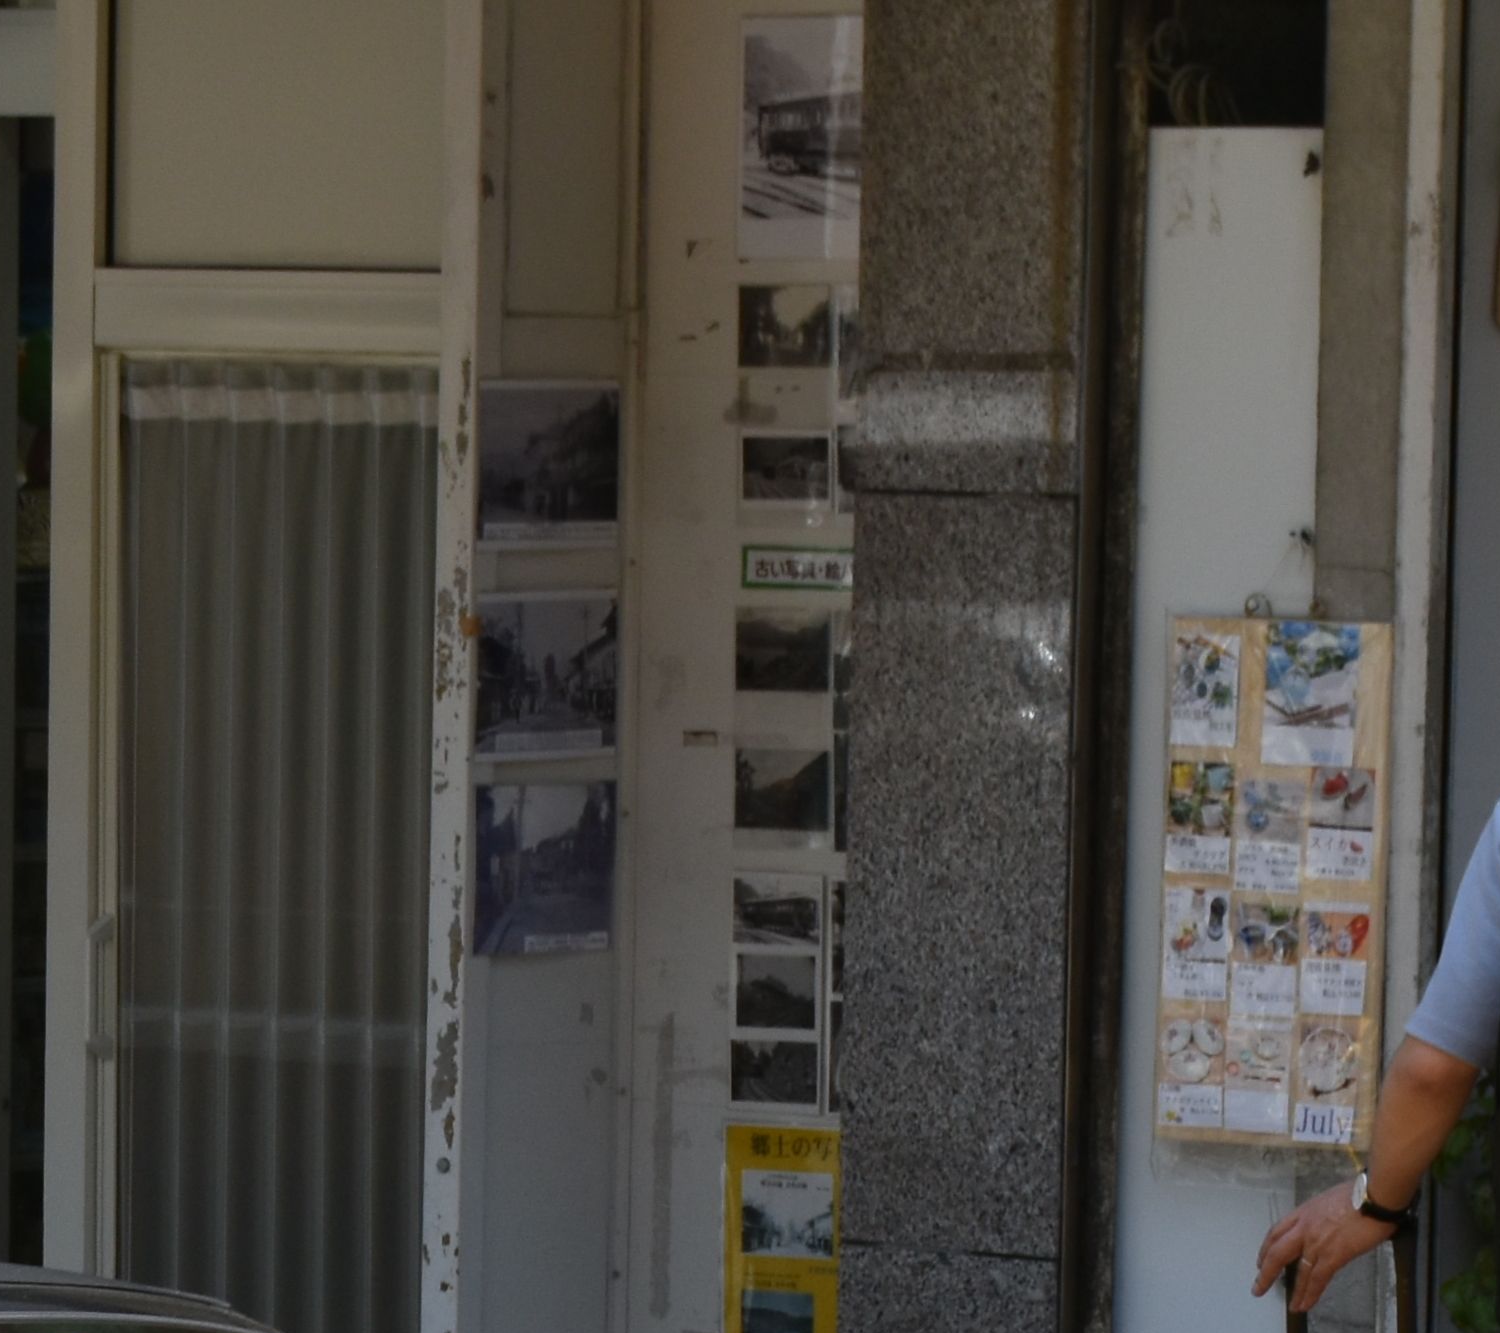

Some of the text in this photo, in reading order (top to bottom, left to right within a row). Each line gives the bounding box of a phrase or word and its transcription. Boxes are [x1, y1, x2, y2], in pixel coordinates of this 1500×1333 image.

[1295, 1107, 1351, 1143] July
[751, 1132, 840, 1161] 郷土の写
